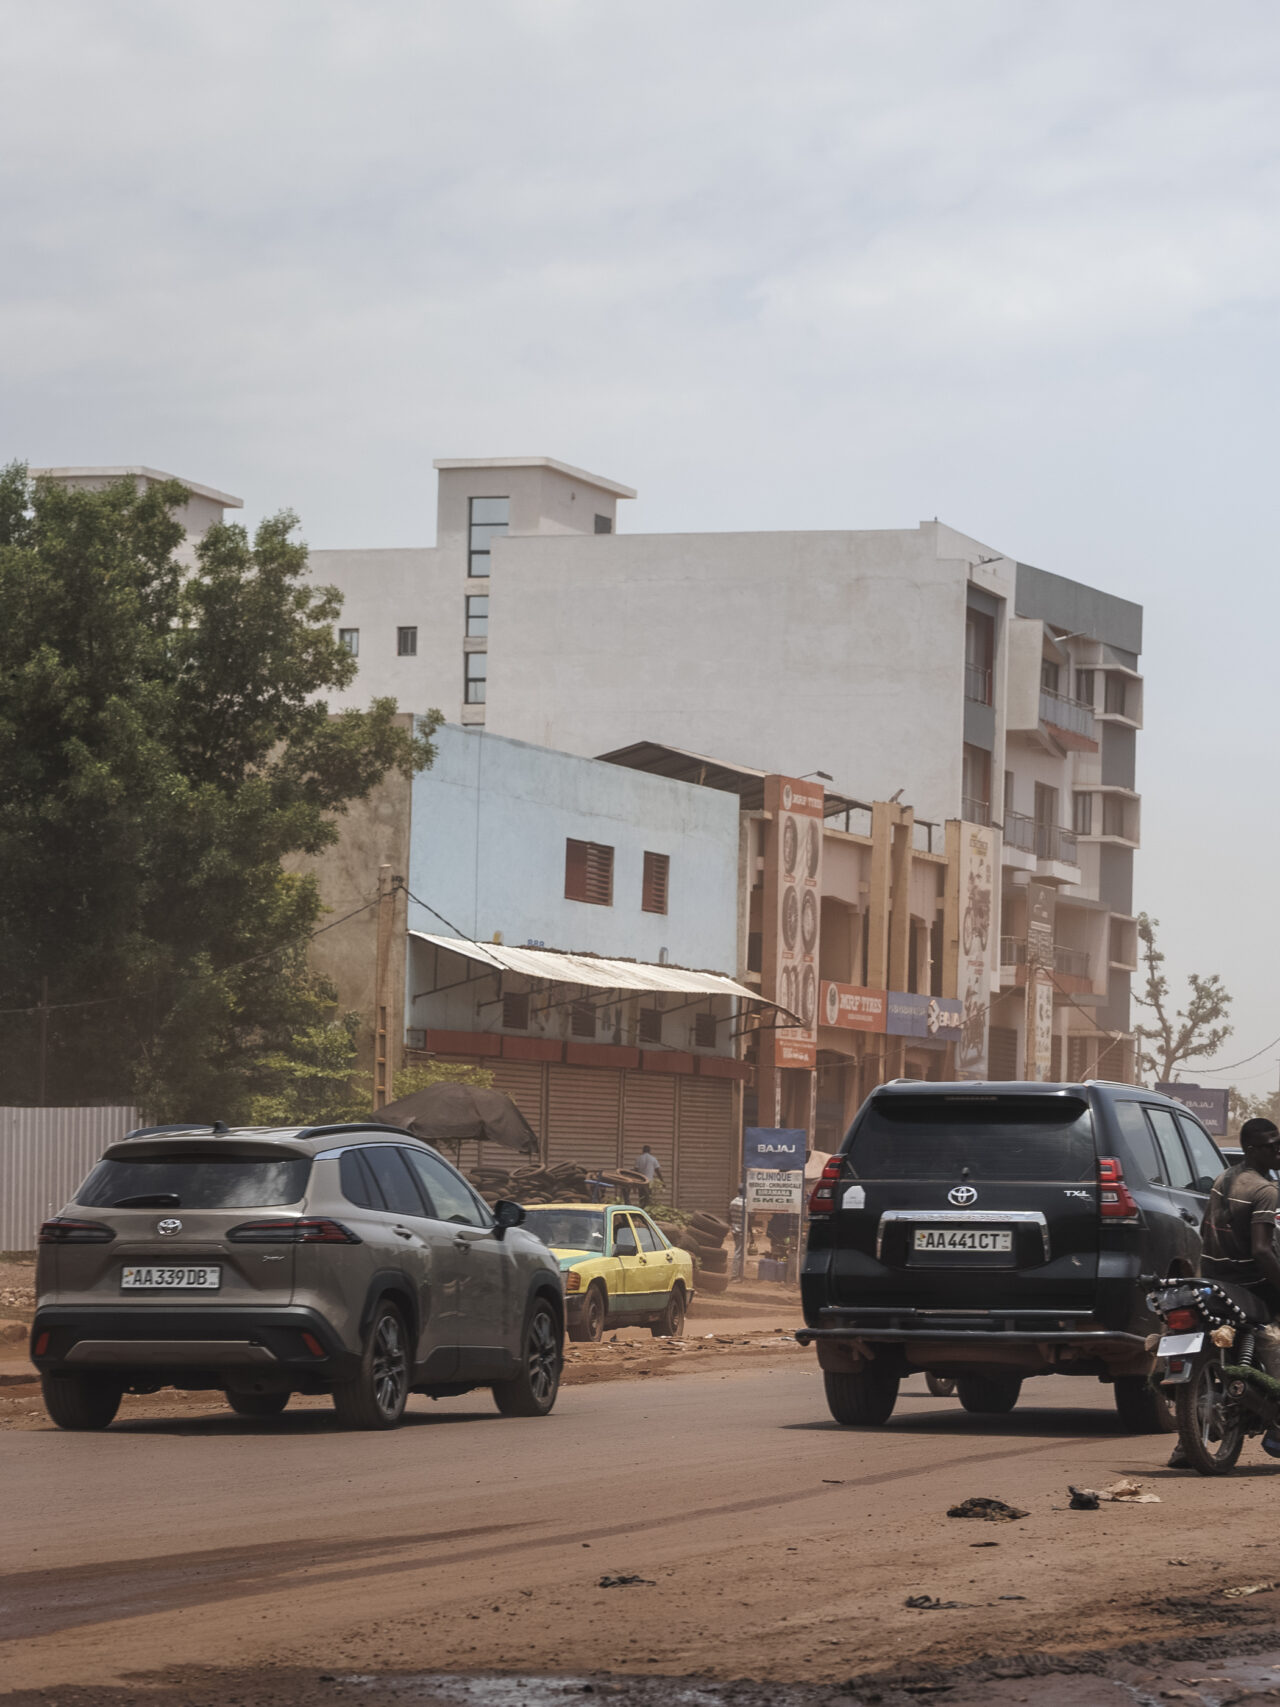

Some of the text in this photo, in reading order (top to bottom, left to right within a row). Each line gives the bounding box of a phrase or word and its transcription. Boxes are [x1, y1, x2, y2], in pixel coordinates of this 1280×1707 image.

[757, 1144, 796, 1153] BAJAJ
[756, 1172, 792, 1181] CLINIQUE
[925, 1232, 1000, 1249] AA441CT
[132, 1269, 208, 1285] AA339DB
